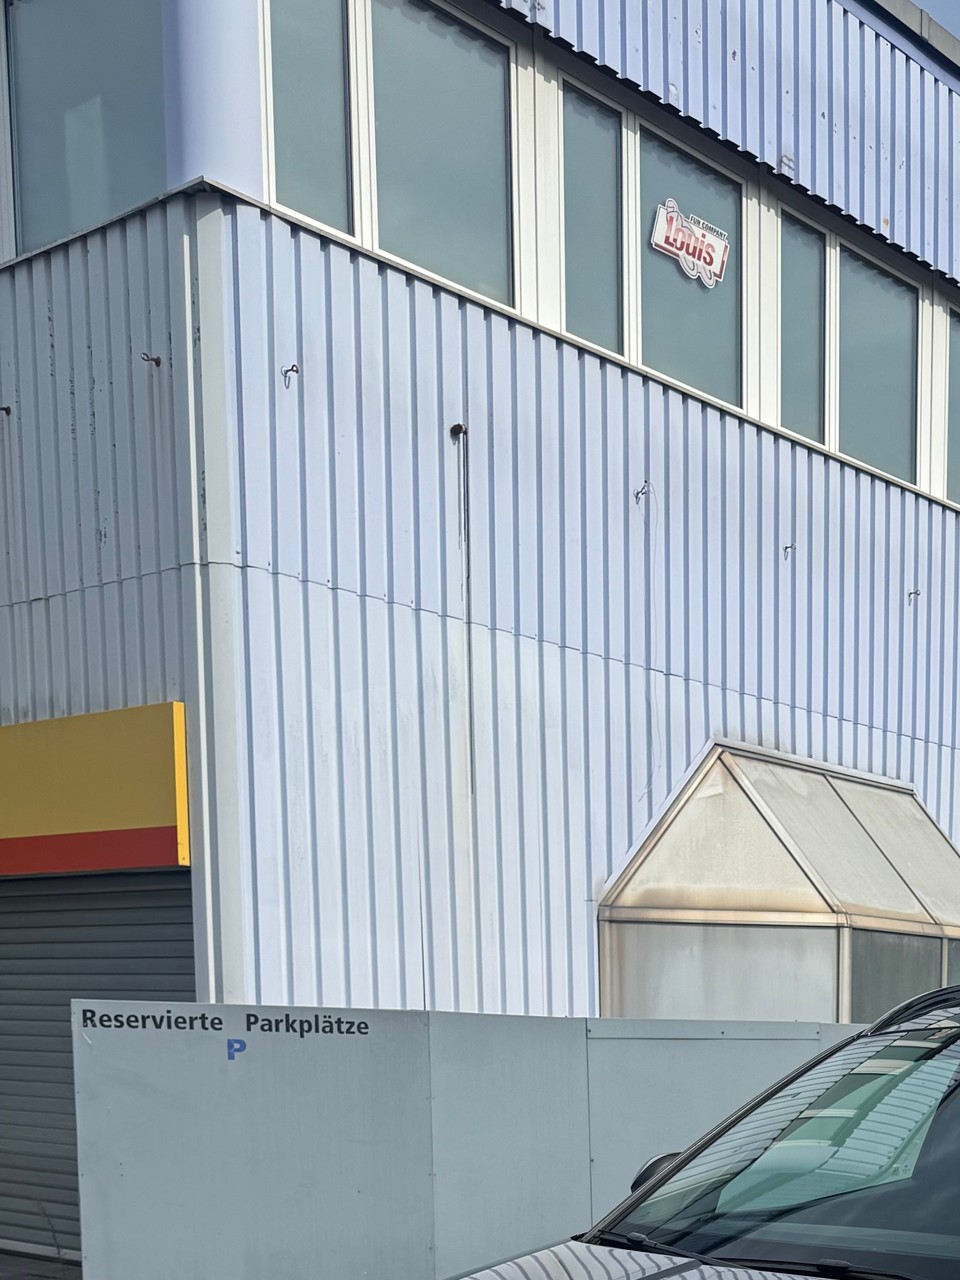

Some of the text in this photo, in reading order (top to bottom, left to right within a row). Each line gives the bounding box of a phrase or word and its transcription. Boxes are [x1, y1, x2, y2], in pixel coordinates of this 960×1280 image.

[664, 215, 717, 267] Louis
[689, 215, 728, 240] FUN COMPANY
[81, 1008, 370, 1039] Reservierte Parkplätze
[226, 1038, 247, 1061] P
